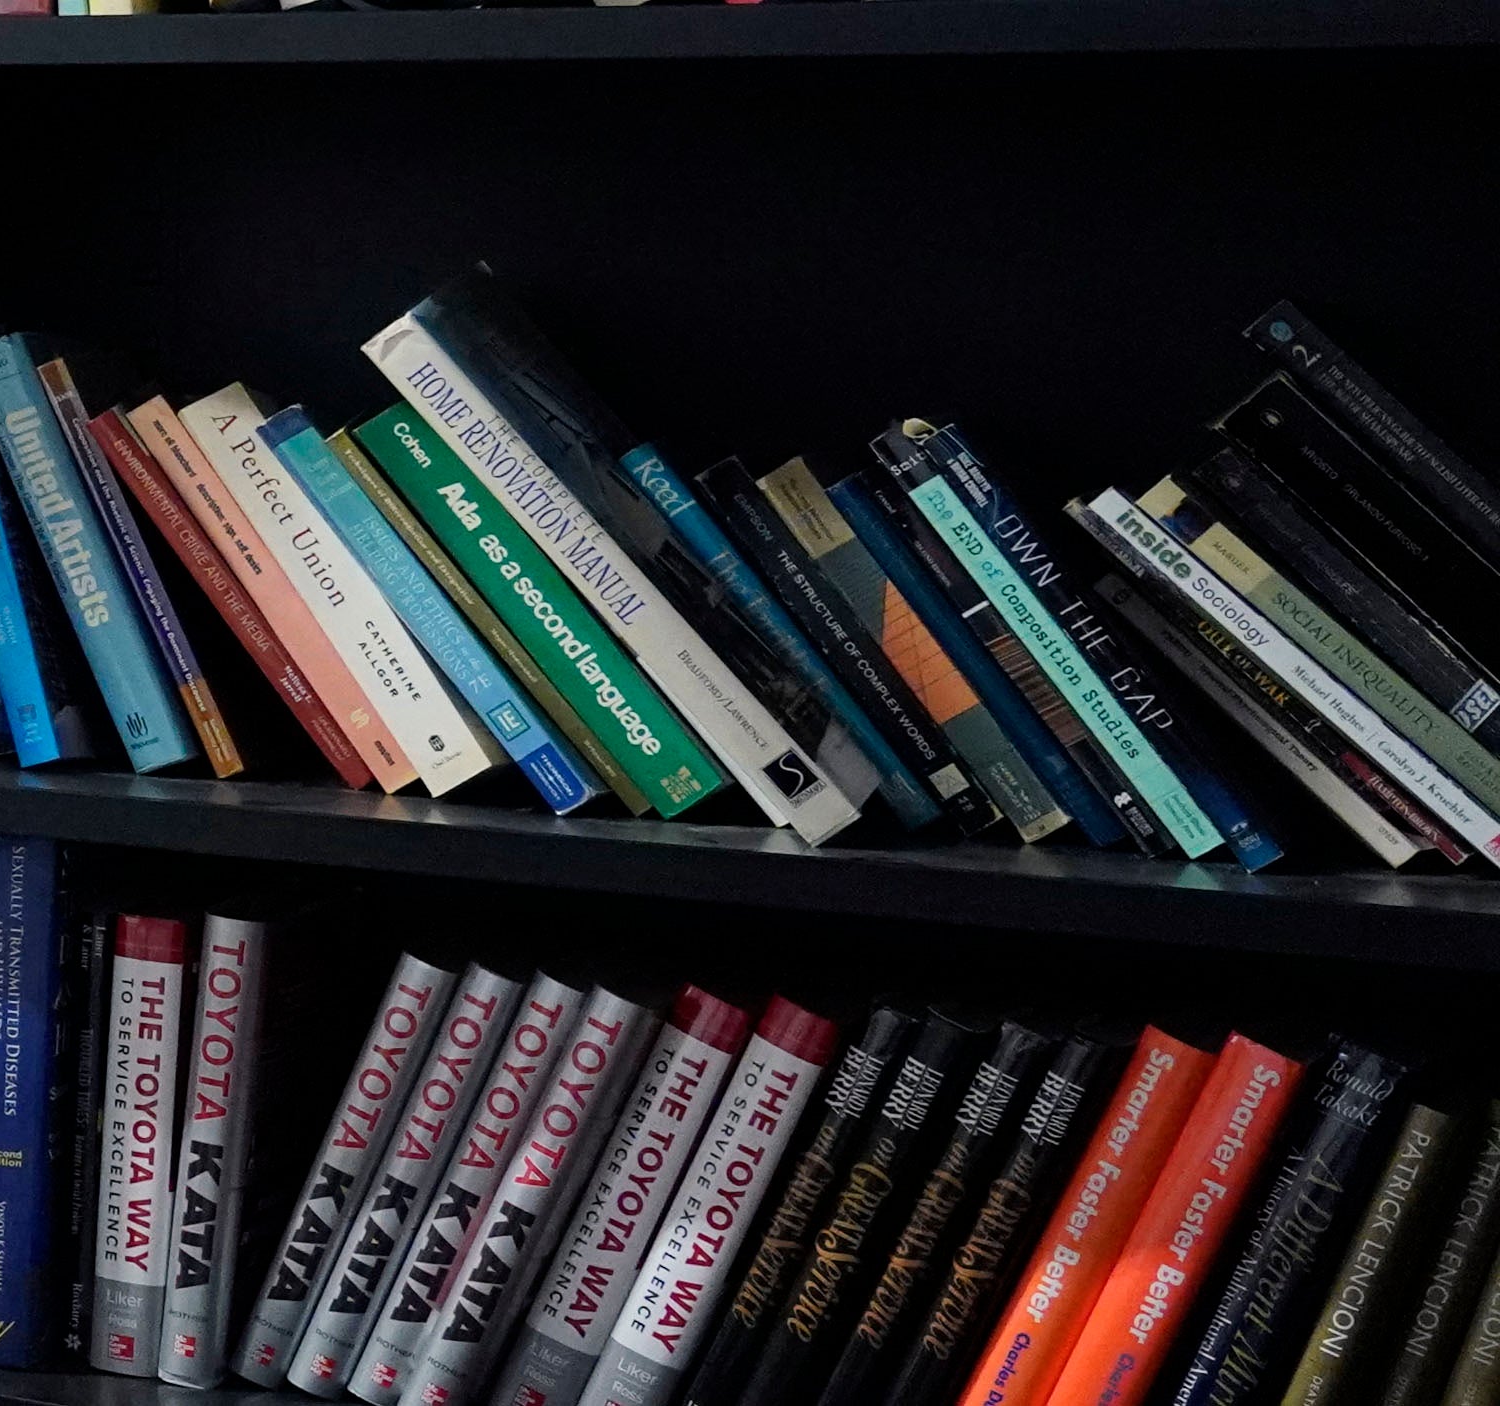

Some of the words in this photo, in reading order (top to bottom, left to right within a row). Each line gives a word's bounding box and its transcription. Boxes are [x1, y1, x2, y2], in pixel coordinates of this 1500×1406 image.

[391, 419, 435, 470] Cohen
[404, 358, 474, 431] HOME
[455, 415, 578, 547] RENOVATION
[560, 532, 649, 627] MANUAL
[630, 451, 696, 522] Reed
[2, 403, 74, 519] United
[44, 511, 118, 631] Artists
[110, 437, 186, 532] ENVIRONMENTAL
[177, 528, 211, 568] CRIME
[203, 563, 230, 594] AND
[222, 590, 245, 615] THE
[238, 612, 272, 653] MEDIA
[210, 405, 240, 435] A
[229, 434, 300, 526] Perfect
[289, 525, 354, 607] Union
[436, 476, 487, 533] Ada
[477, 530, 510, 565] as
[499, 558, 523, 581] a
[511, 570, 590, 661] second
[570, 649, 667, 762] language
[926, 489, 956, 522] The
[949, 519, 985, 558] END
[979, 557, 1004, 582] of
[995, 581, 1088, 692] Composition
[1081, 687, 1143, 761] Studies
[990, 510, 1063, 590] OWN
[1055, 594, 1117, 662] THE
[1107, 662, 1177, 738] GAP
[1114, 506, 1196, 583] inside
[1187, 572, 1272, 652] Sociology
[140, 577, 165, 617] Engaging
[158, 615, 171, 631] the
[165, 631, 190, 673] Dominant
[183, 672, 208, 713] Discourse
[358, 640, 399, 698] ALLGOR
[363, 620, 422, 702] CATHERINE
[776, 549, 798, 574] THE
[792, 571, 848, 642] STRUCTURE
[842, 639, 862, 660] OF
[855, 657, 903, 716] COMPLEX
[897, 713, 936, 762] WORDS
[1270, 590, 1337, 650] SOCIAL
[1329, 641, 1440, 738] INEQUALITY
[8, 846, 25, 921] SEXUALLY
[5, 925, 23, 1038] TRANSMITTED
[120, 979, 133, 1003] TO
[138, 976, 164, 1040] THE
[193, 937, 245, 1123] TOYOTA
[3, 1043, 20, 1115] DISEASES
[113, 1016, 130, 1108] SERVICE
[129, 1053, 160, 1184] TOYOTA
[877, 1055, 927, 1128] BERRY
[1104, 1045, 1176, 1160] Smarter
[1313, 1082, 1381, 1126] Takaki
[1325, 1060, 1395, 1101] Ronald
[104, 1120, 125, 1261] EXCELLENCE
[124, 1197, 151, 1271] WAY
[174, 1140, 224, 1292] KATA
[1062, 1157, 1121, 1245] Faster
[1371, 1129, 1431, 1233] PATRICK
[1024, 1243, 1082, 1327] Better
[1318, 1238, 1385, 1358] LENCIONI
